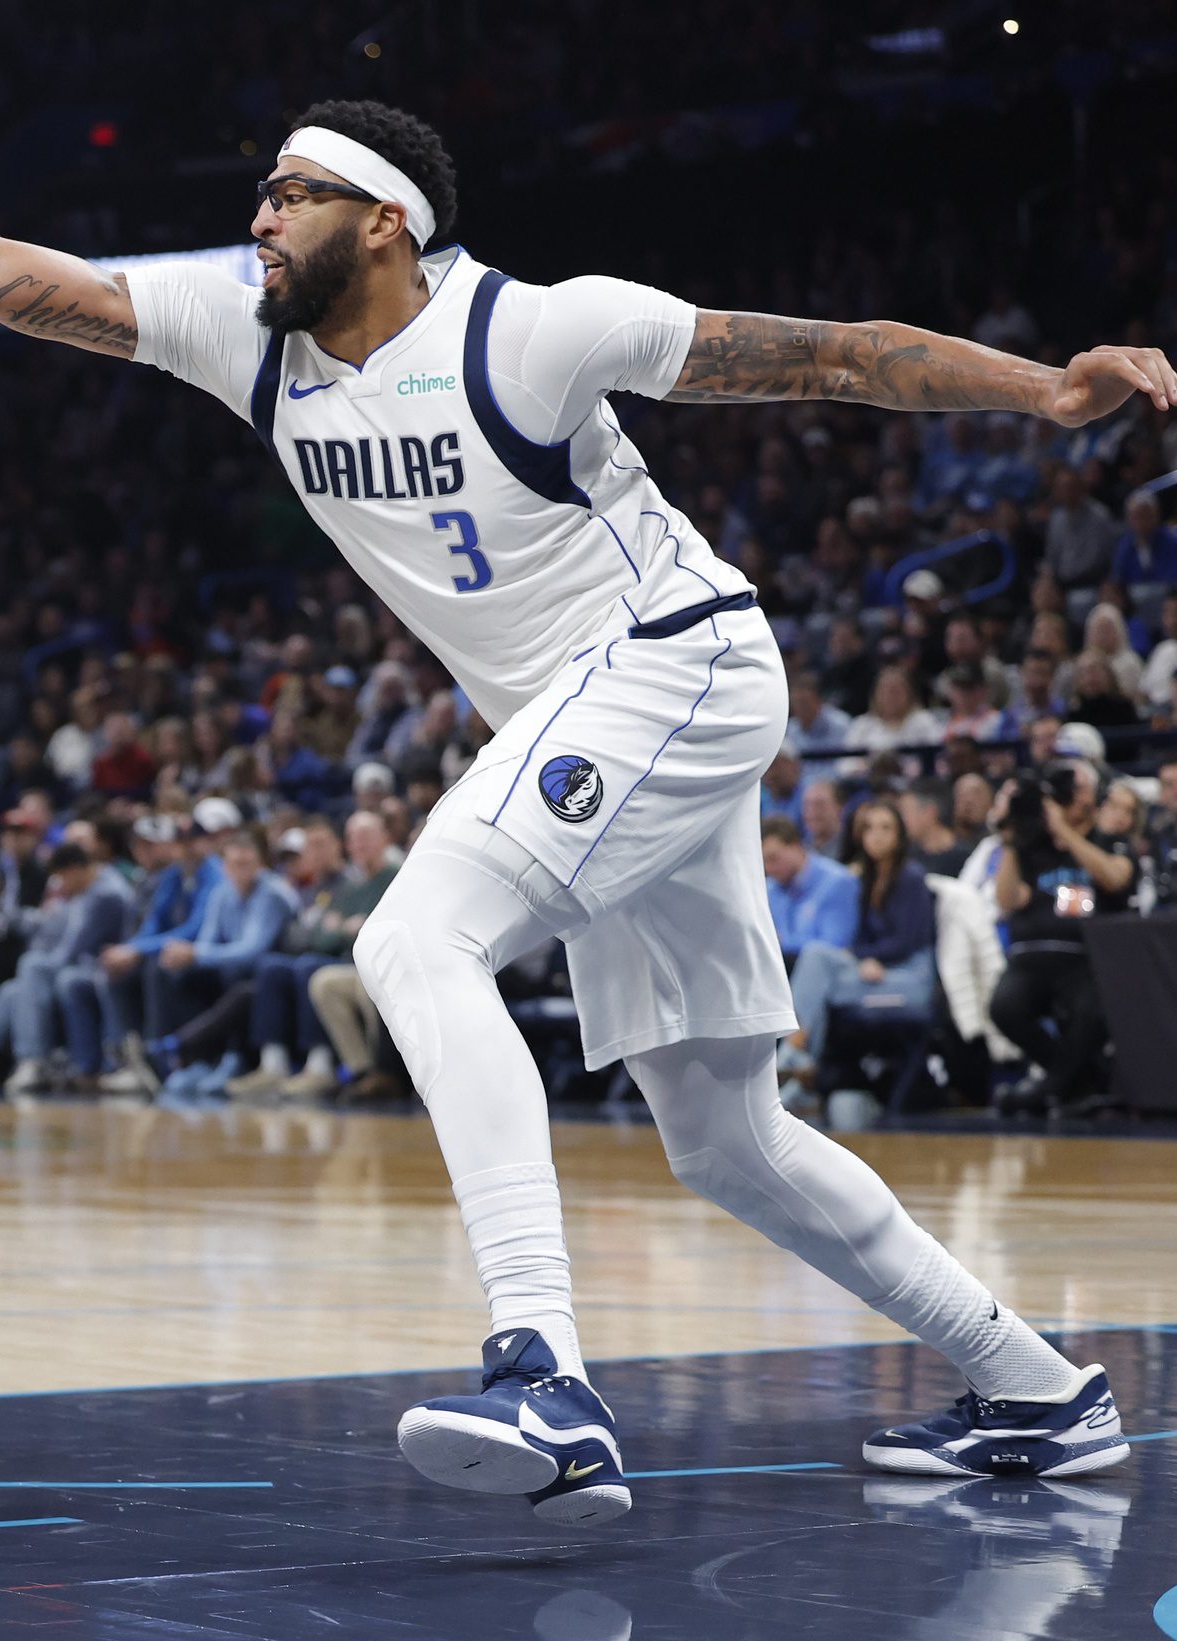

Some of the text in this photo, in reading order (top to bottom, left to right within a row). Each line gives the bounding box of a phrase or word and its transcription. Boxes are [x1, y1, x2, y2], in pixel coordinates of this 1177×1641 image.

[397, 372, 456, 396] chime
[292, 430, 466, 501] DALLAS
[429, 508, 494, 594] 3
